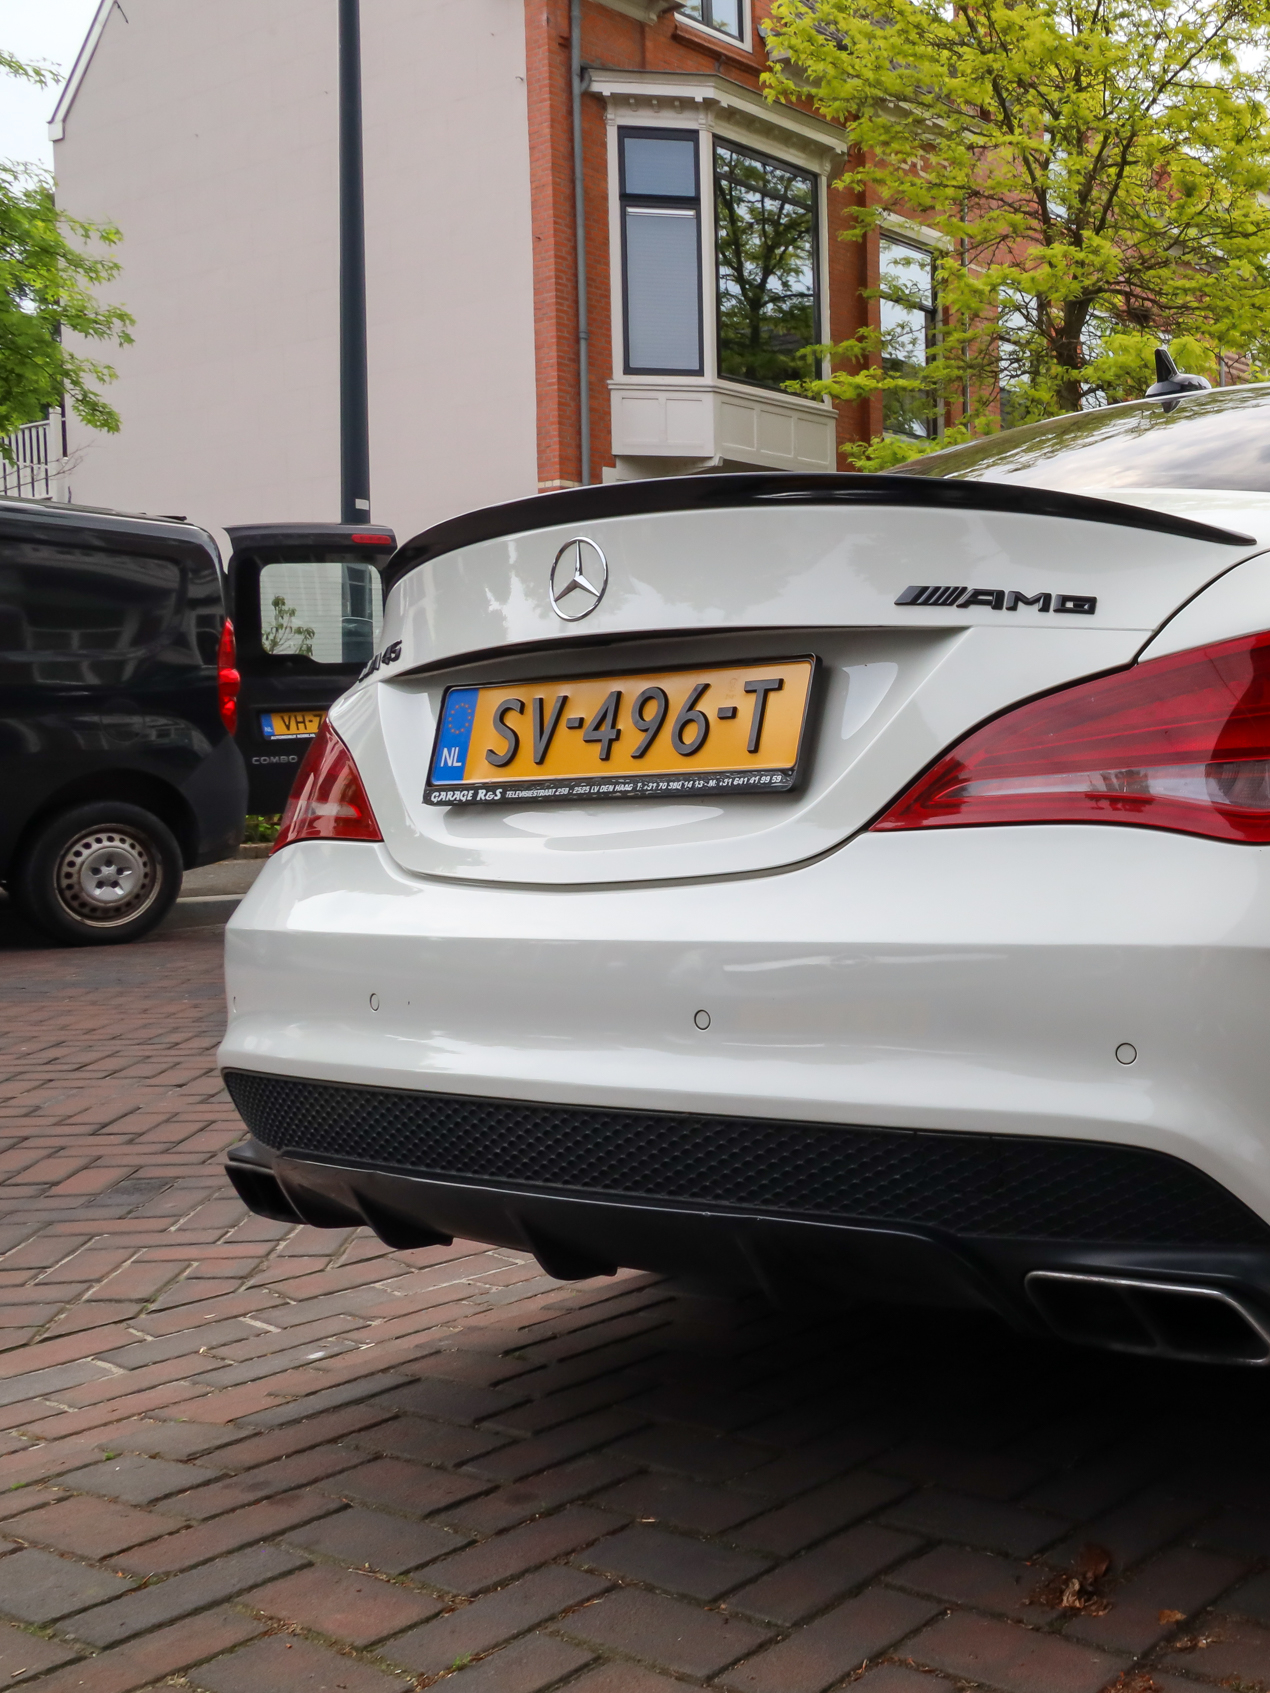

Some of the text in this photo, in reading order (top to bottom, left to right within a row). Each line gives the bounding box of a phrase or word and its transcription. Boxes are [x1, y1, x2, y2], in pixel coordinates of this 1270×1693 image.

[956, 588, 1098, 614] AMG
[485, 678, 784, 768] SV-496-T
[252, 755, 298, 765] COMBO
[440, 747, 462, 768] NL
[430, 790, 474, 803] GARAGE
[476, 789, 503, 801] R&S
[590, 785, 600, 793] LV
[599, 784, 613, 792] DEN
[614, 783, 634, 791] HAAG
[760, 775, 770, 783] 99
[771, 775, 782, 783] 59
